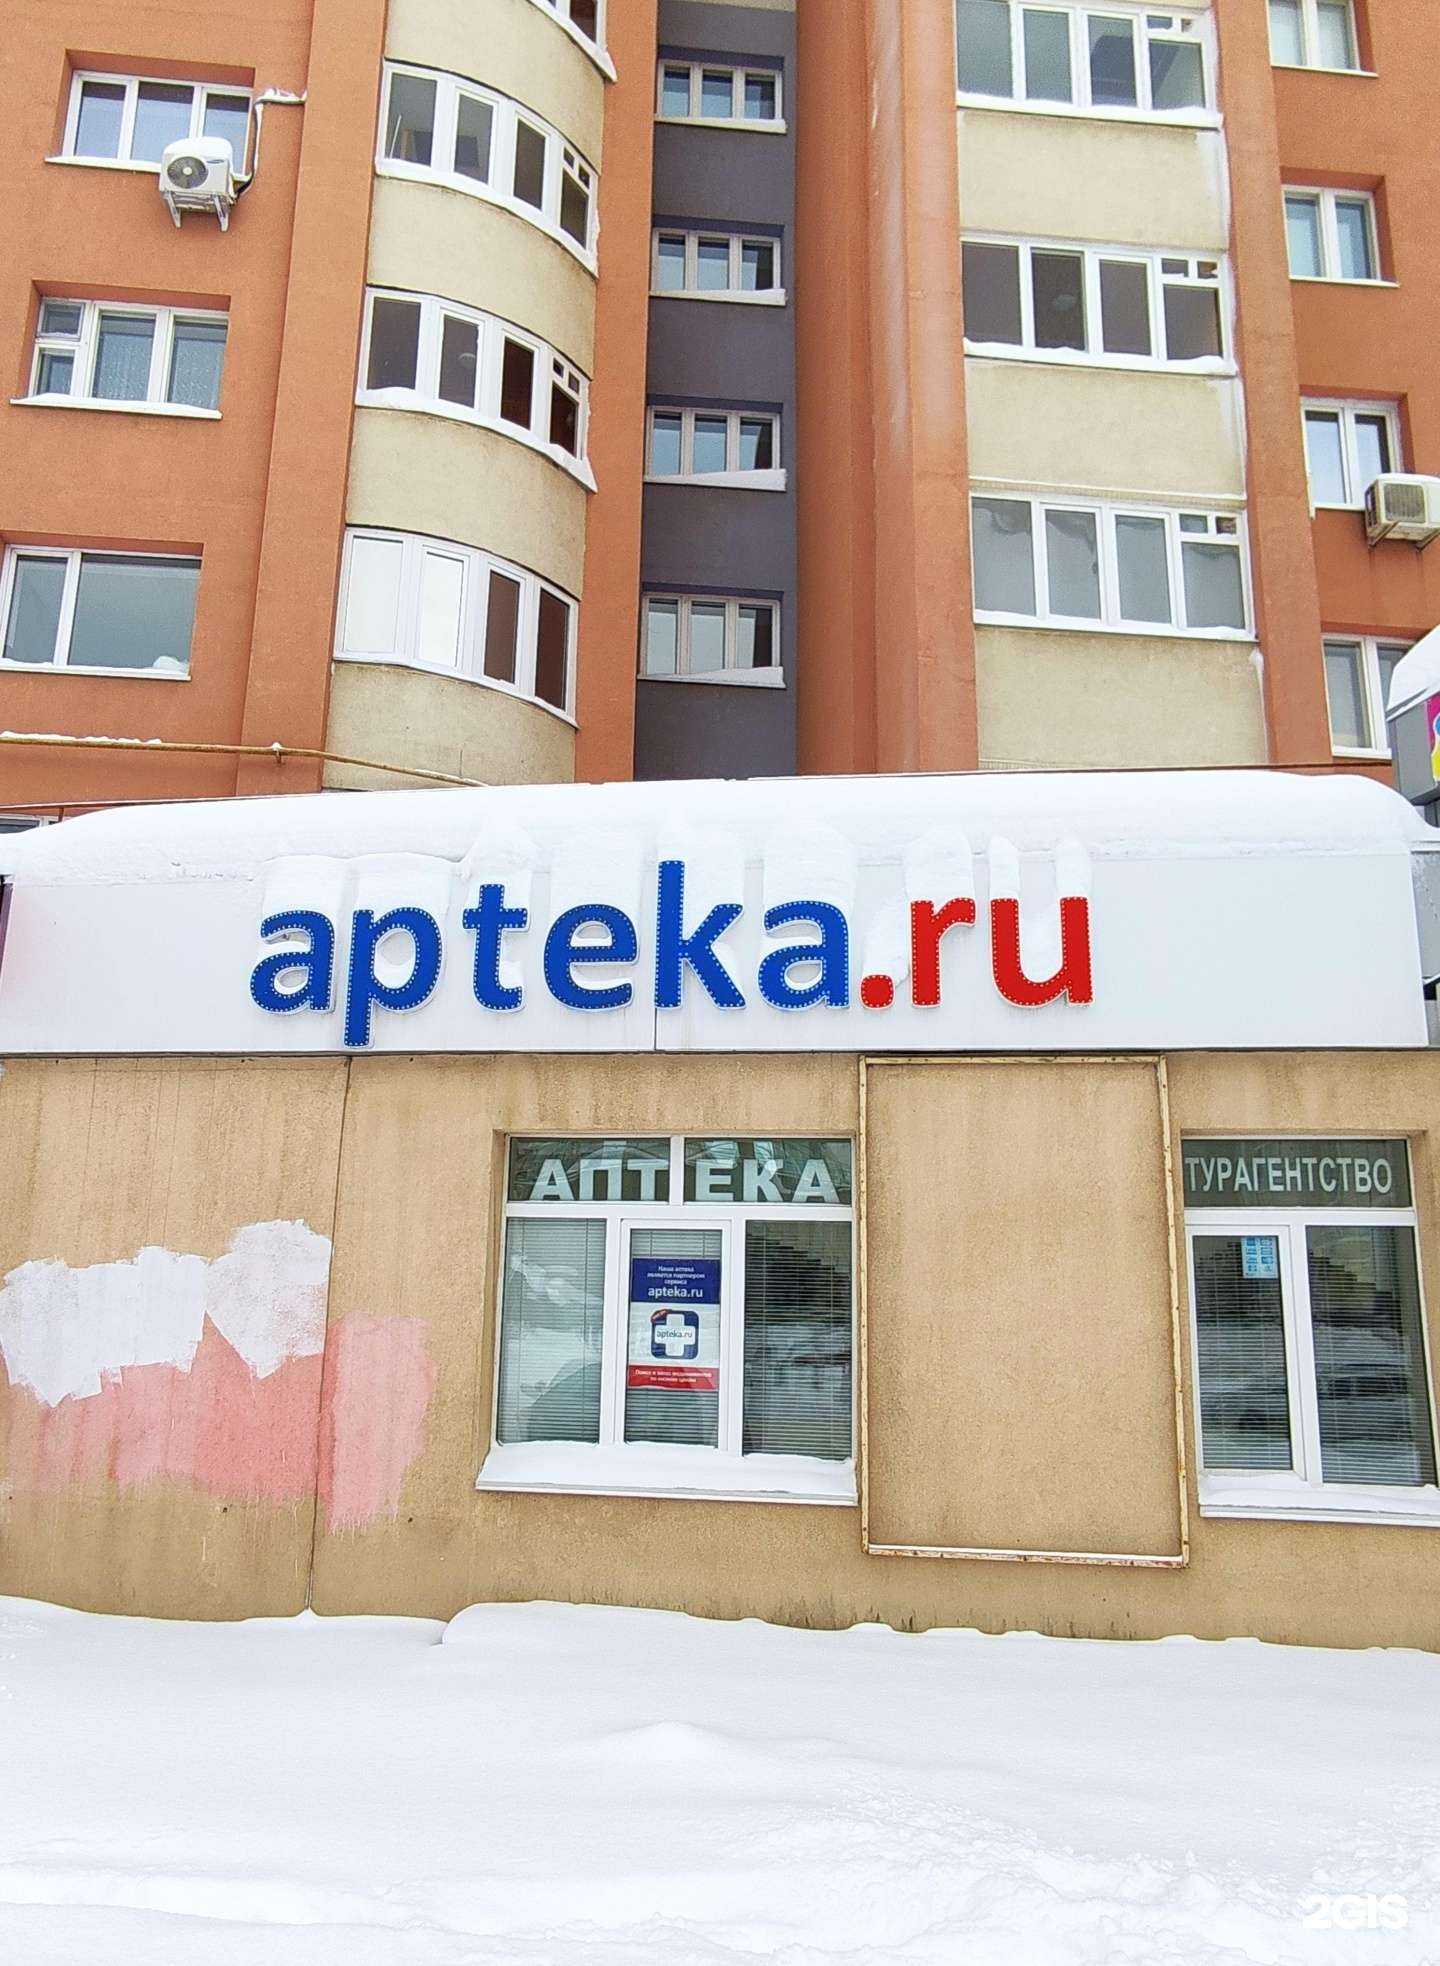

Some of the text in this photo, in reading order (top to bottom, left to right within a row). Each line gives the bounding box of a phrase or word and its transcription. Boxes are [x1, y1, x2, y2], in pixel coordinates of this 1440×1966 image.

[249, 860, 1094, 1049] apteka.ru
[529, 1158, 840, 1203] АПТЕКА
[1185, 1156, 1393, 1194] ТУРАГЕНТСТВО
[647, 1286, 703, 1298] apteka.ru
[656, 1330, 693, 1339] apteka.ru
